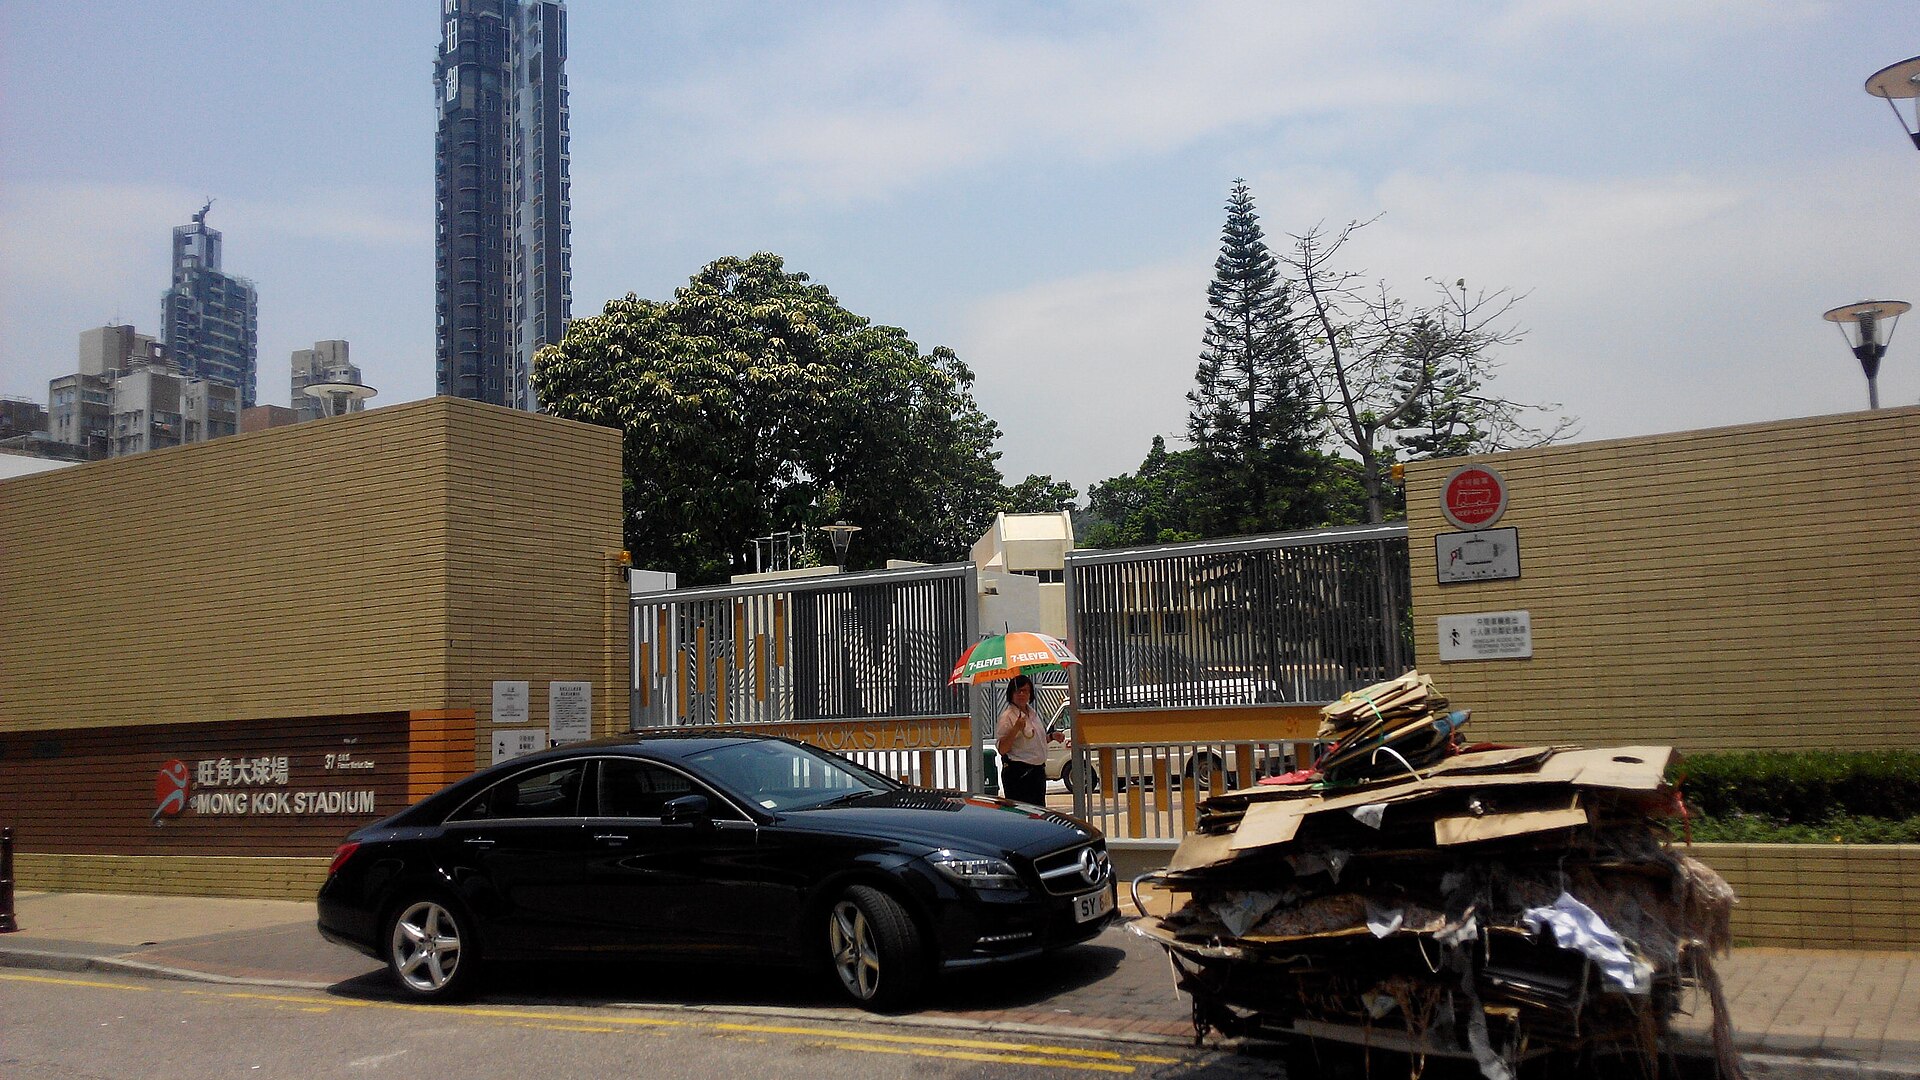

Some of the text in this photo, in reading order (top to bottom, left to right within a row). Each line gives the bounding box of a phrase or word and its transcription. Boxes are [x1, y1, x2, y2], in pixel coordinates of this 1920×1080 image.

[816, 722, 860, 750] KOK
[863, 719, 961, 748] STADIUM
[197, 756, 289, 786] 旺角大球場
[325, 753, 335, 769] 37
[196, 790, 374, 814] MONG KOK STADIUM
[1081, 898, 1096, 916] SY
